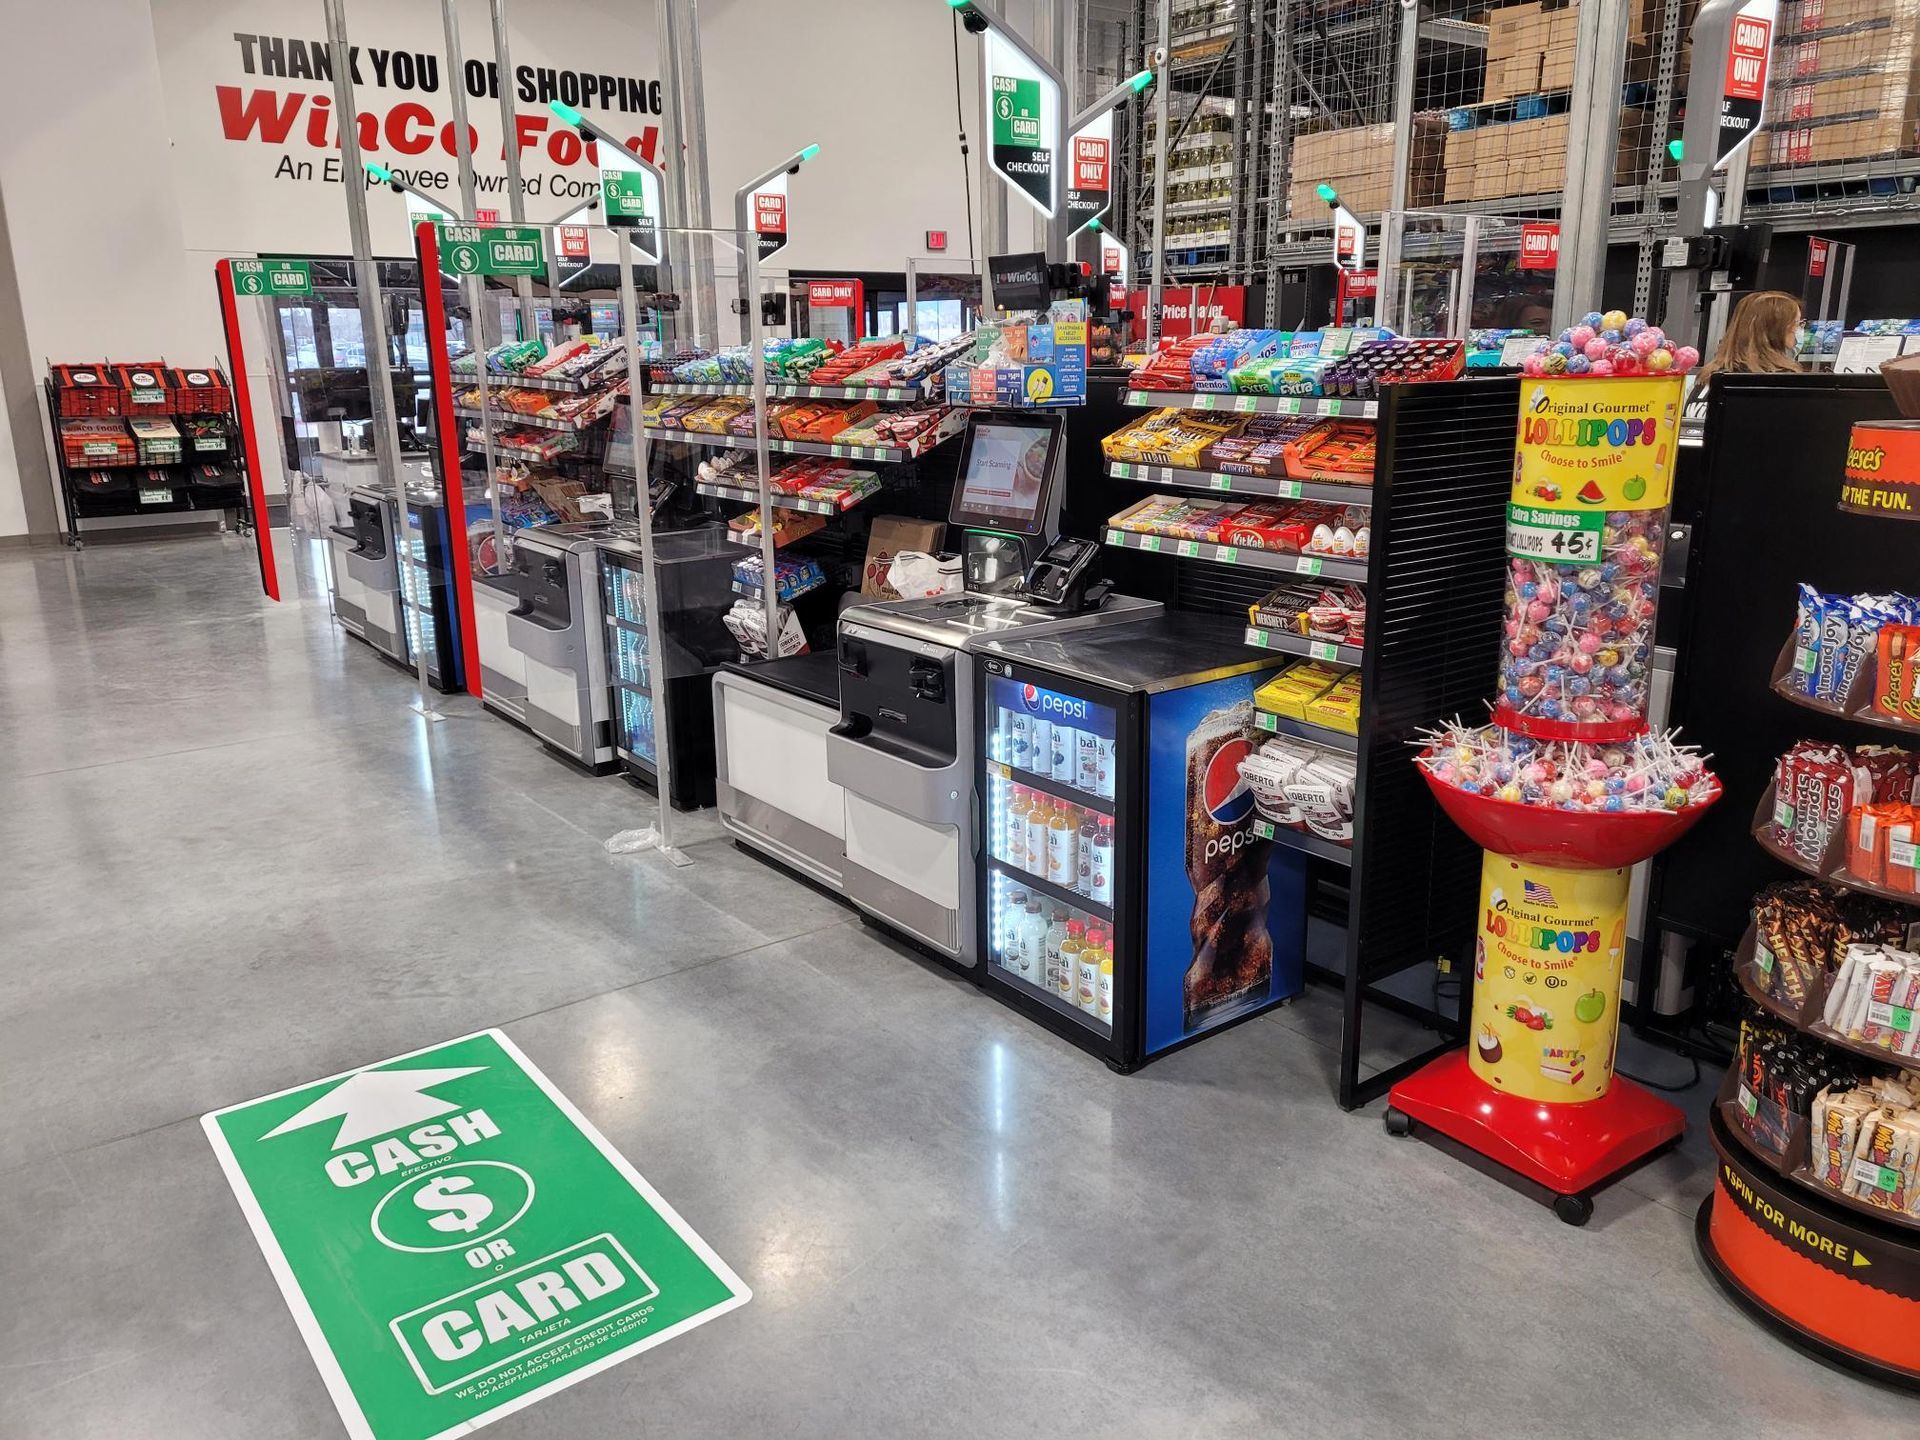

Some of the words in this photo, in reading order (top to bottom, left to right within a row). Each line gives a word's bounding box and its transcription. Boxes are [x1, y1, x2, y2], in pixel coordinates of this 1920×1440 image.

[1736, 22, 1765, 49] CARD
[233, 32, 364, 86] THANK
[368, 47, 439, 93] YOU
[516, 65, 662, 115] SHOPPING
[1733, 57, 1761, 83] ONLY
[993, 77, 1017, 92] CASH
[215, 85, 479, 158] WinCo
[1013, 120, 1037, 135] CARD
[1032, 151, 1050, 162] SELF
[1079, 141, 1104, 158] CARD
[275, 154, 313, 181] An
[602, 170, 622, 180] CASH
[1006, 161, 1050, 174] CHECKOUT
[1080, 163, 1103, 180] ONLY
[621, 198, 641, 208] CARD
[759, 196, 781, 209] CARD
[638, 218, 653, 226] SELF
[760, 212, 781, 225] ONLY
[445, 227, 482, 243] CASH
[505, 229, 518, 240] OR
[564, 228, 584, 238] CARD
[566, 240, 584, 250] ONLY
[1525, 234, 1549, 251] CARD
[494, 244, 535, 262] CARD
[236, 261, 264, 273] CASH
[273, 273, 305, 286] CARD
[1007, 271, 1038, 284] WinCo
[812, 287, 832, 297] CARD
[834, 286, 852, 298] ONLY
[1162, 304, 1187, 319] Price
[1195, 380, 1228, 390] mentos
[1535, 395, 1588, 416] Original
[1523, 416, 1657, 447] LOLLIPOPS
[975, 458, 989, 467] Start
[989, 459, 1012, 471] Scanning
[1540, 449, 1574, 468] Choose
[1576, 458, 1588, 469] to
[1591, 453, 1622, 469] Smile
[1850, 487, 1871, 506] THE
[1872, 489, 1911, 510] FUN.
[1530, 509, 1581, 528] Savings
[1255, 612, 1289, 629] HERSHEY'S
[1823, 616, 1841, 645] Joy
[1881, 658, 1903, 713] Reese's
[1042, 694, 1087, 720] pepsi
[1080, 734, 1097, 750] bai
[1244, 770, 1274, 788] OBERTO
[1291, 791, 1325, 804] OBERTO
[1800, 778, 1823, 862] Mounds
[1496, 899, 1540, 923] Original
[1485, 908, 1601, 954] LOLLIPOPS
[1497, 941, 1528, 967] Choose
[1530, 958, 1542, 970] to
[1544, 960, 1575, 971] Smile
[1768, 933, 1804, 998] HEATH
[1542, 1047, 1580, 1059] PARTY
[324, 1108, 502, 1188] CASH
[401, 1155, 453, 1178] EFECTIVO
[1730, 1171, 1754, 1204] SPIN
[1755, 1197, 1786, 1229] FOR
[1788, 1219, 1849, 1262] MORE
[464, 1238, 517, 1269] OR
[421, 1252, 626, 1361] CARD
[519, 1317, 572, 1344] TARJETA
[455, 1384, 477, 1400] WE
[478, 1375, 497, 1390] DO
[499, 1364, 524, 1381] NOT
[526, 1343, 572, 1368] ACCEPT
[574, 1324, 614, 1347] CREDIT
[616, 1305, 656, 1327] CARDS
[474, 1388, 490, 1401] NO
[491, 1362, 550, 1390] ACEPTAMOS
[550, 1341, 596, 1366] TARJETAS
[596, 1335, 610, 1347] DE
